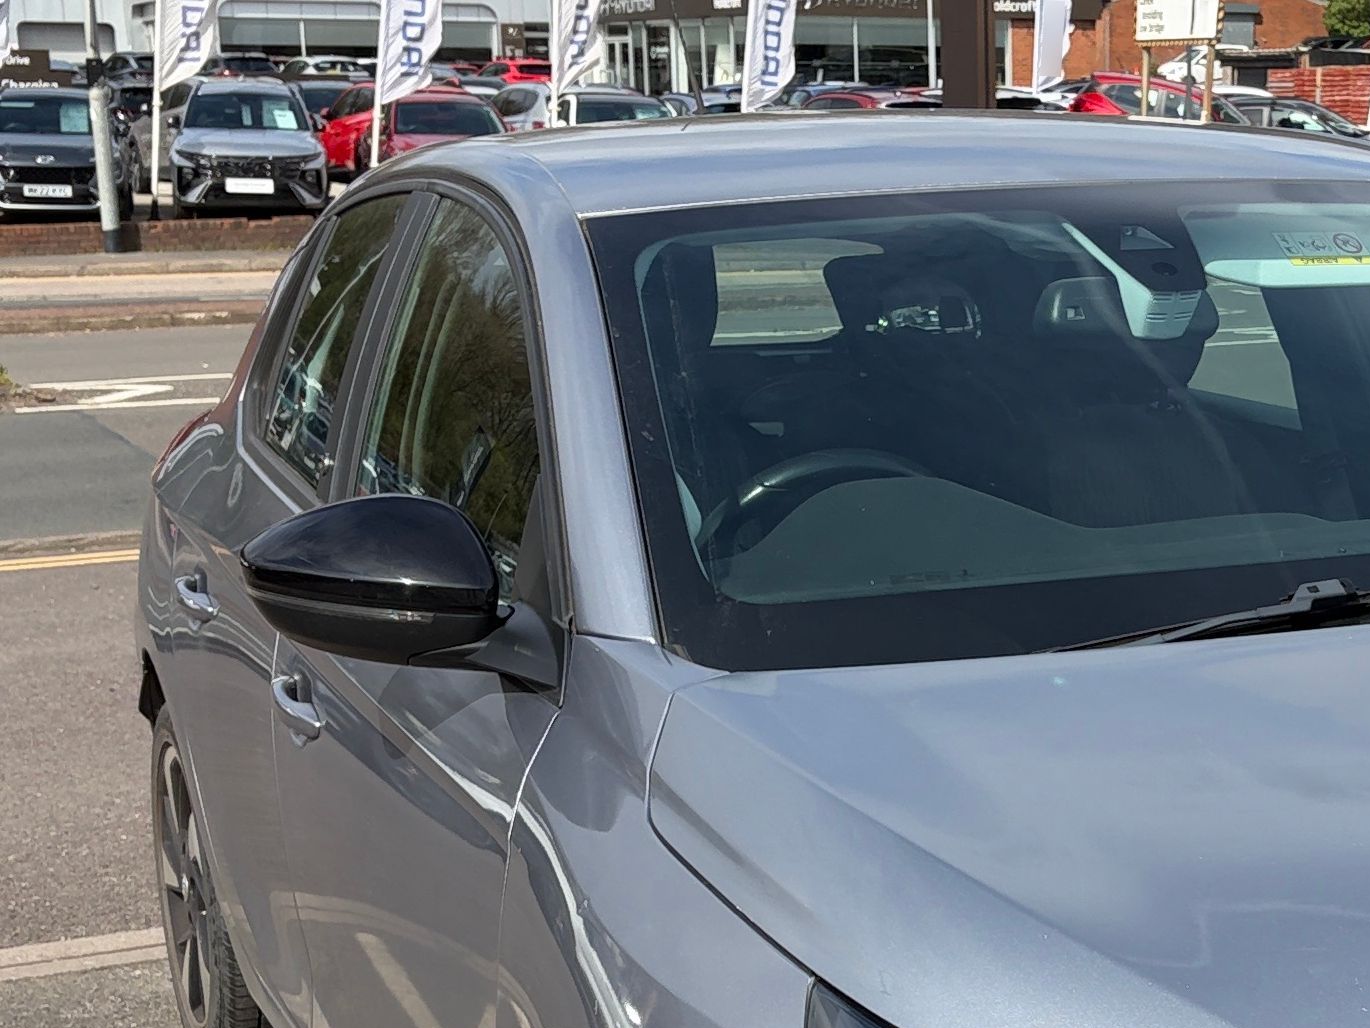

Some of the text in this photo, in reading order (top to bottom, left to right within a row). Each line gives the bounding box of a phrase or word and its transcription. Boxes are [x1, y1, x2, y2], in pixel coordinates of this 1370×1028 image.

[181, 0, 205, 64] DAI
[993, 0, 1036, 12] oldcroft
[761, 0, 785, 87] NDAI
